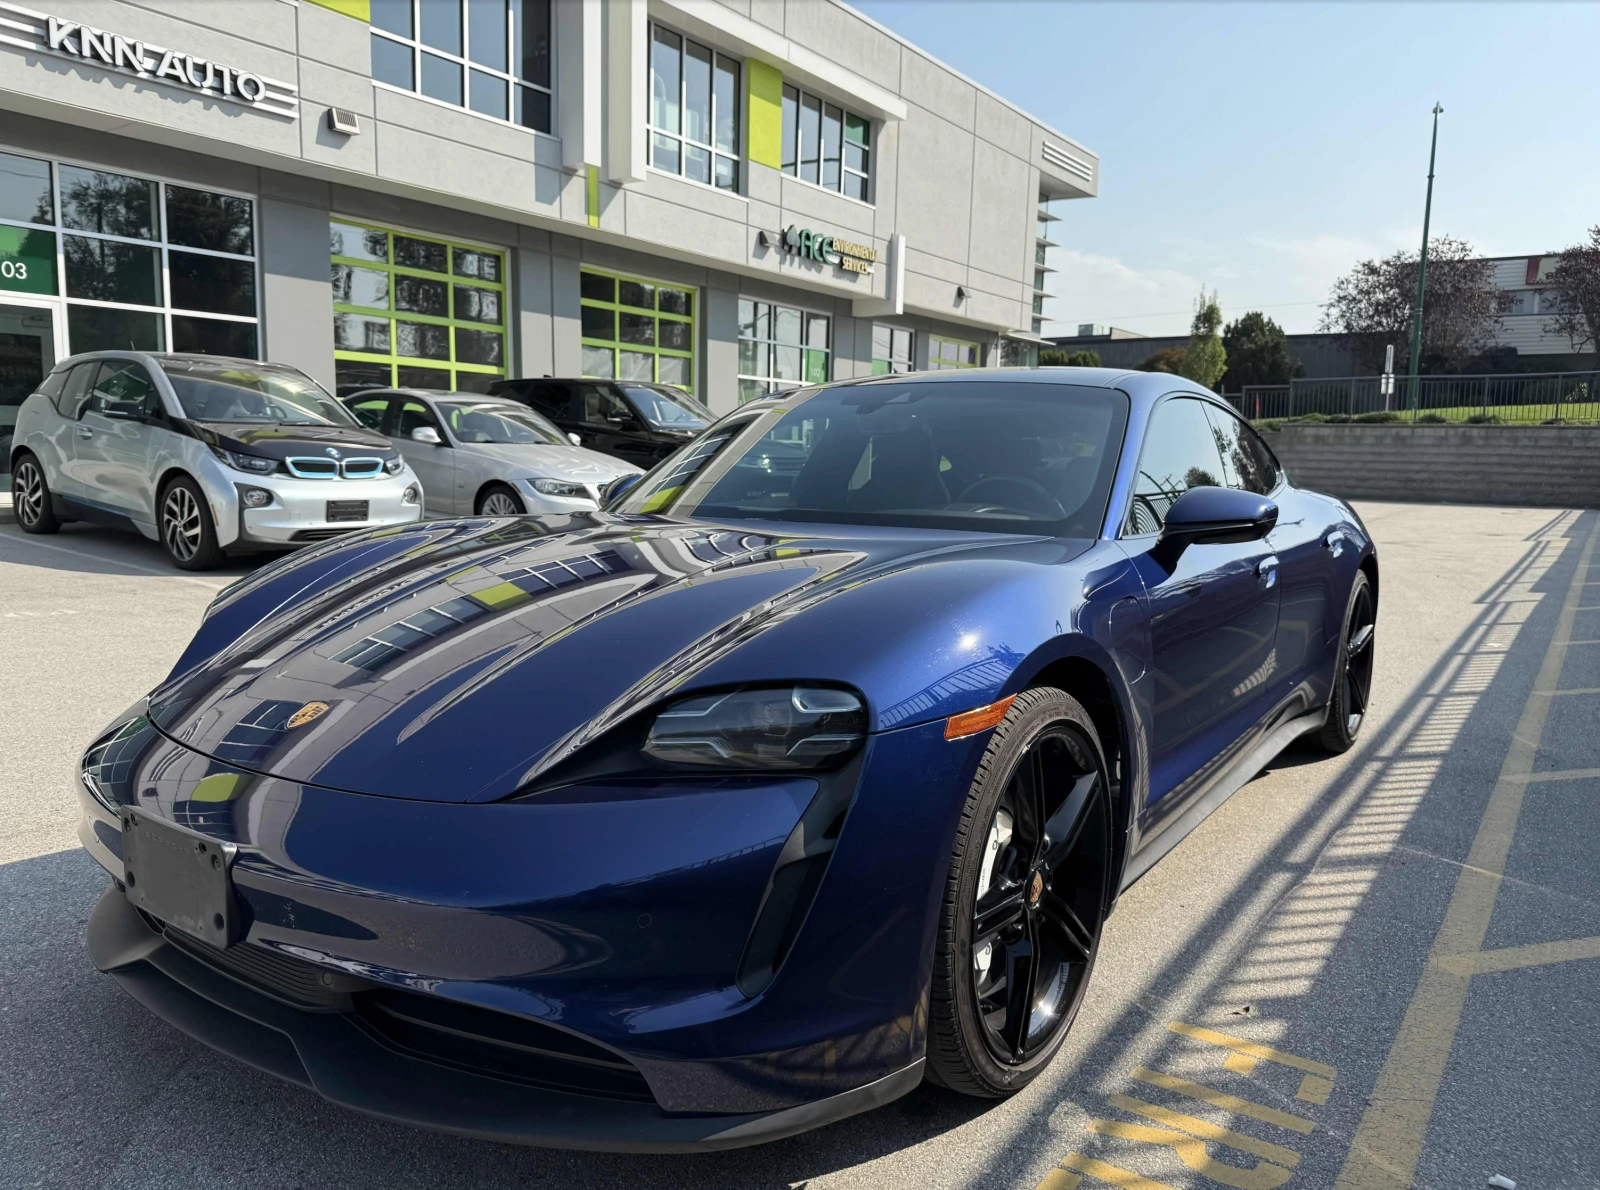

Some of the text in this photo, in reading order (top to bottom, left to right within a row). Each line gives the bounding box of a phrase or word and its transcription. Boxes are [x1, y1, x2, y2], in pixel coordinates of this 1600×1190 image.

[46, 16, 266, 101] KNN AUTO
[801, 229, 834, 265] ACE
[843, 256, 869, 274] SERVICES
